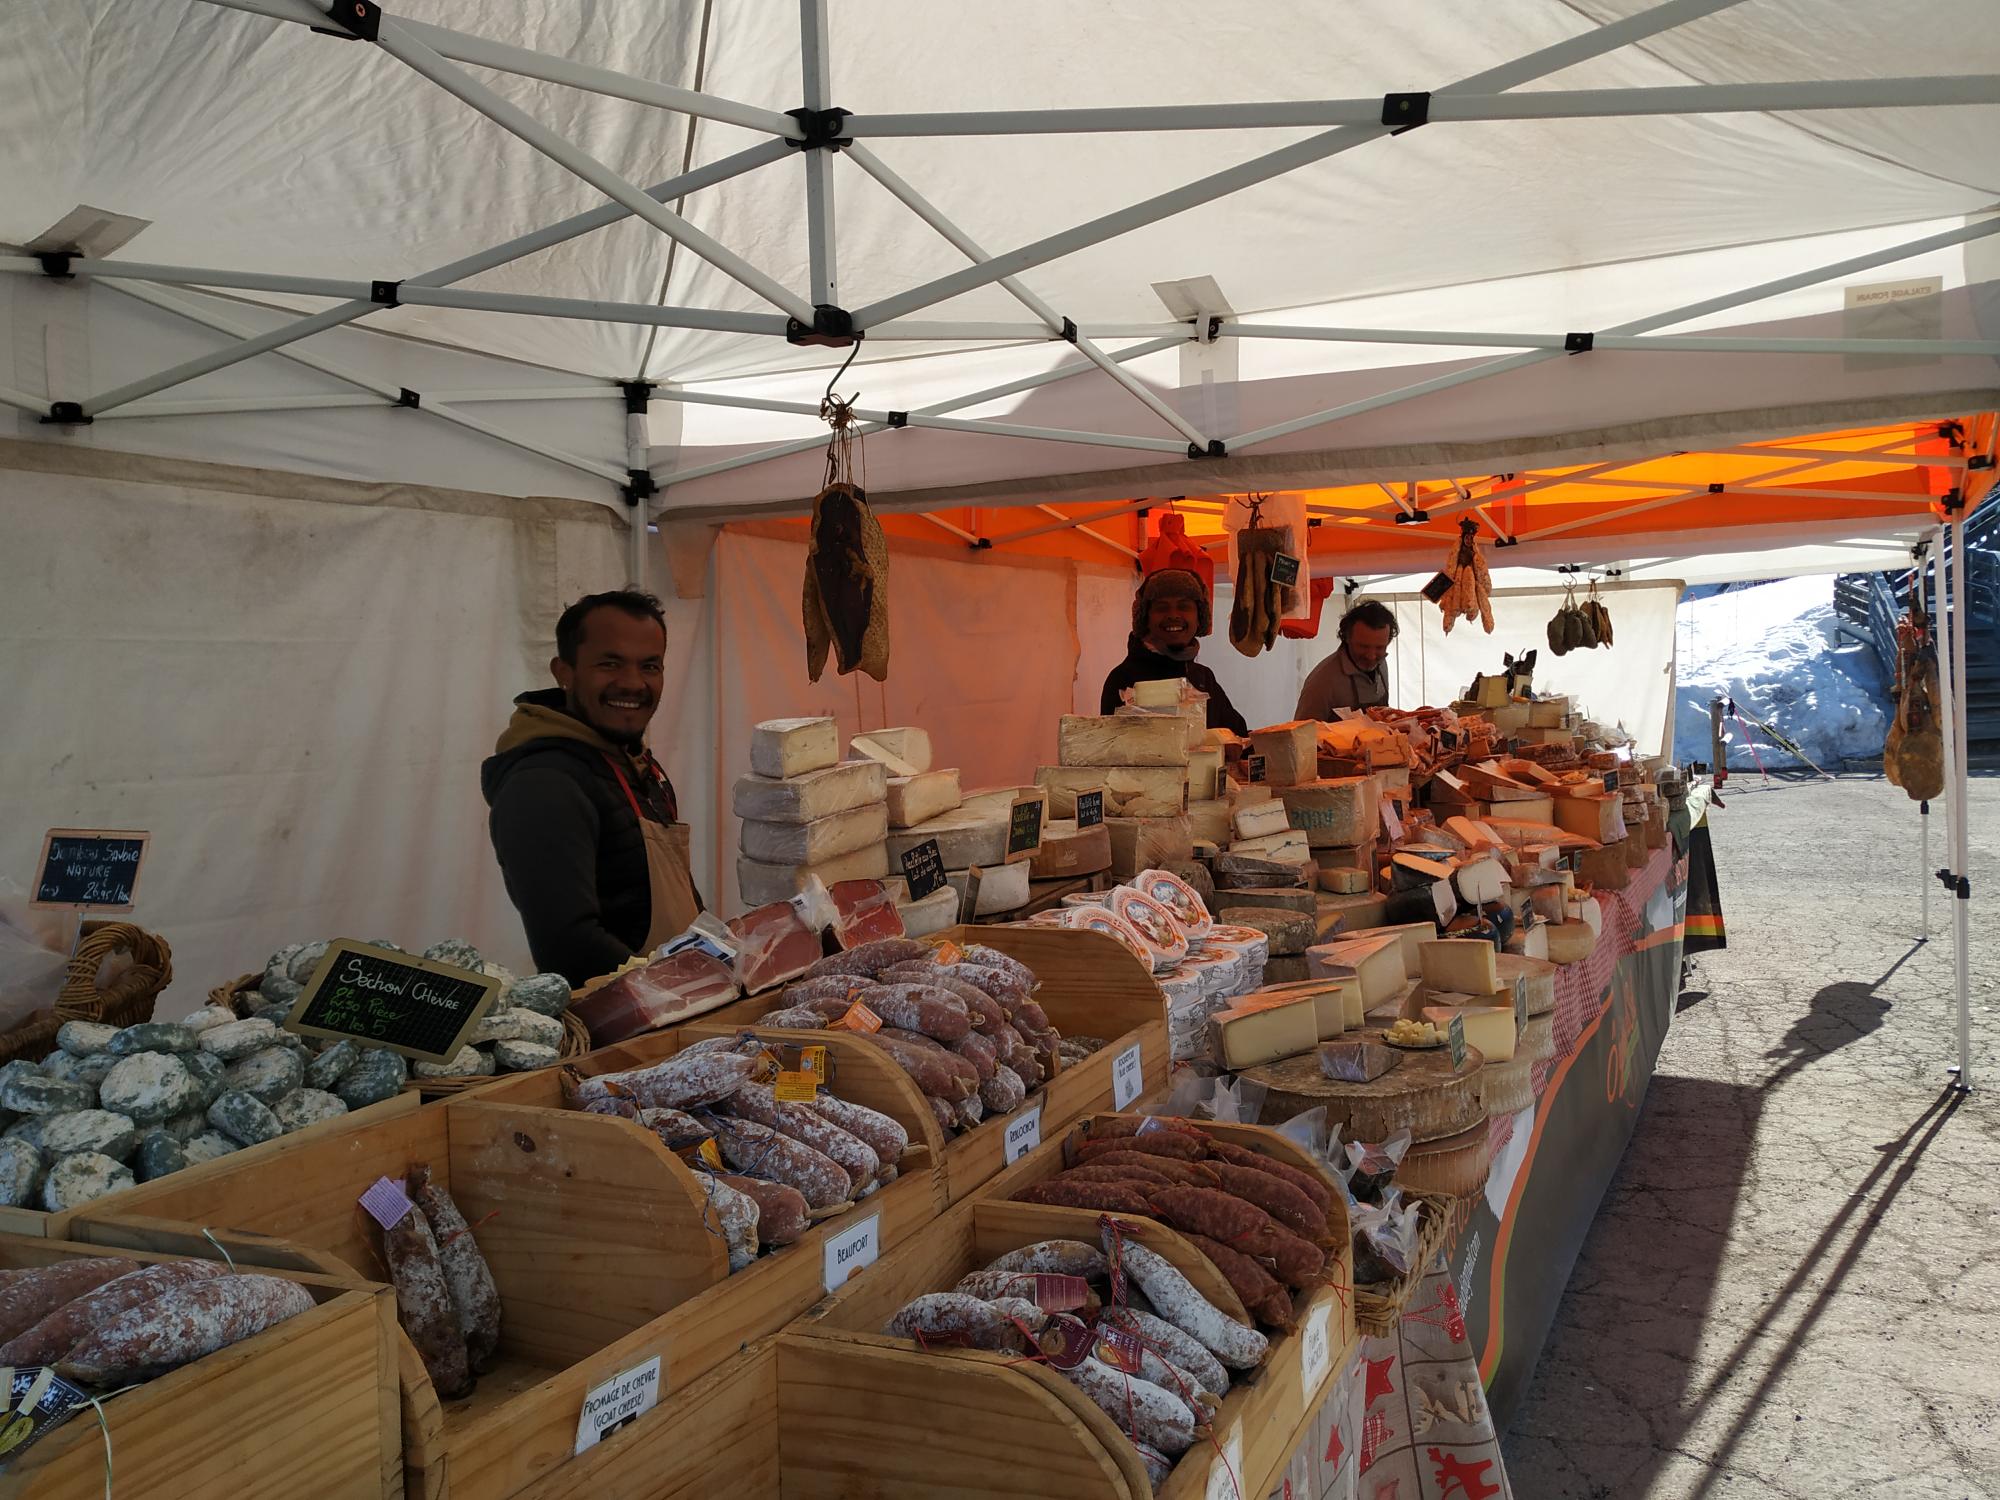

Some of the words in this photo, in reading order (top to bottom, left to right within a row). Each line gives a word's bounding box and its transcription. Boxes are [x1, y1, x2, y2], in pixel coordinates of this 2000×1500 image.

[66, 862, 112, 878] NATURE
[372, 1019, 389, 1036] 5
[837, 1234, 868, 1265] BEAUFORT
[583, 1387, 621, 1417] FROMAGE
[621, 1381, 632, 1397] DE
[632, 1368, 657, 1391] CHEVRE
[593, 1406, 617, 1431] (GOAT
[617, 1390, 645, 1416] CHEESE)
